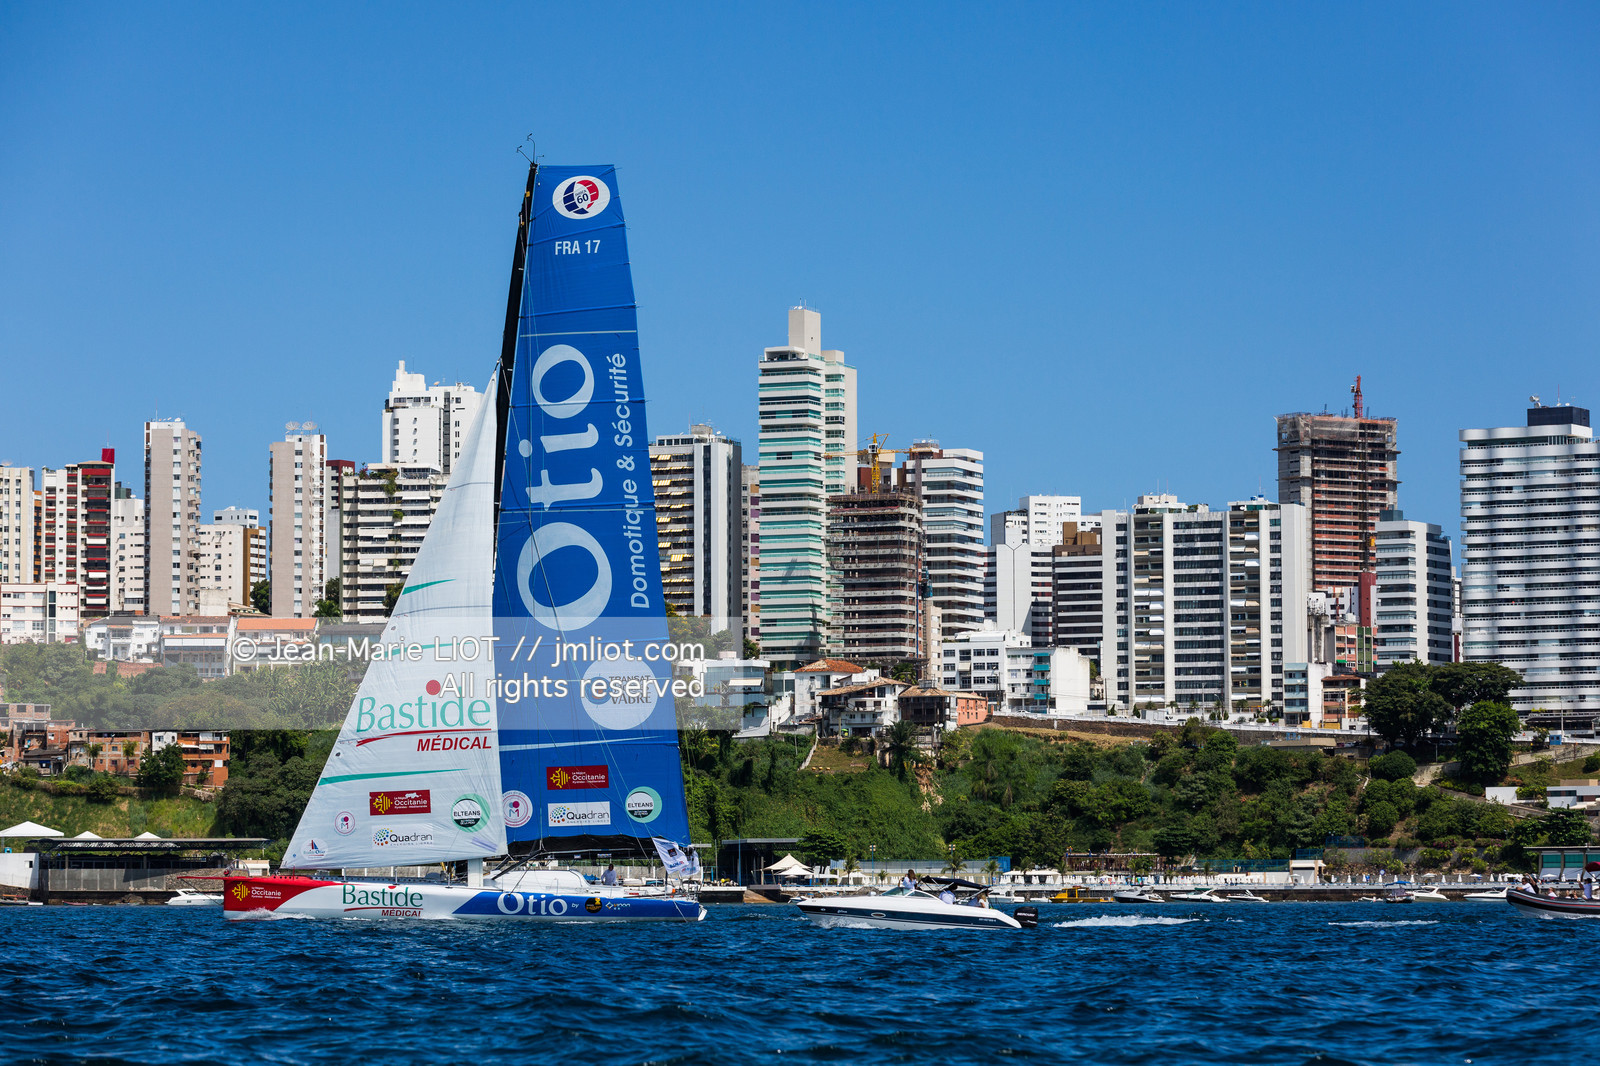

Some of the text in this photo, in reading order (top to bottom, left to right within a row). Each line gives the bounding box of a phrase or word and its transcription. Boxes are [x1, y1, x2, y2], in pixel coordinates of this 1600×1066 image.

[576, 193, 589, 204] 60
[554, 239, 601, 256] FRA 17
[516, 344, 612, 632] Otio
[605, 353, 650, 609] Domotique & Sécurité
[356, 680, 491, 732] Bastide
[417, 735, 492, 752] MÉDICAL
[571, 773, 606, 781] Occitanie
[393, 798, 428, 806] Occitanie
[566, 810, 609, 820] Quadran
[389, 832, 433, 843] Quadran
[342, 882, 424, 907] Bastide
[496, 892, 568, 916] Otio
